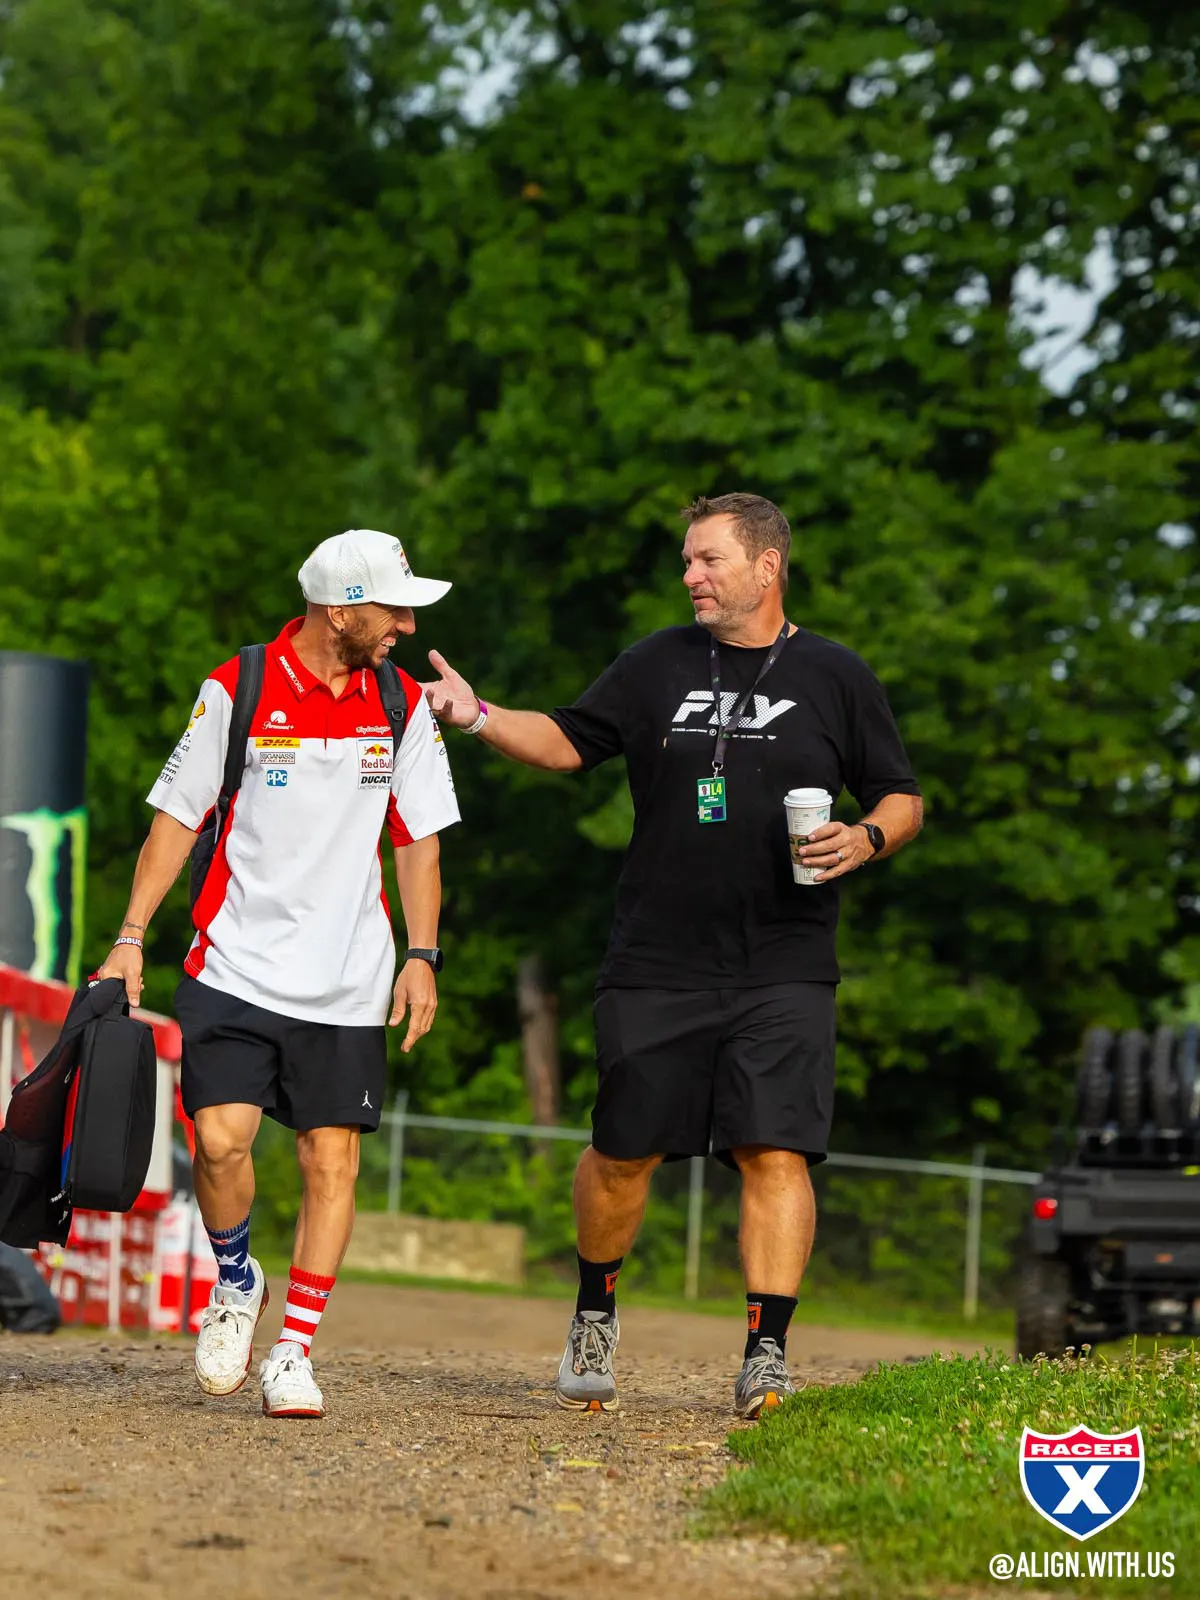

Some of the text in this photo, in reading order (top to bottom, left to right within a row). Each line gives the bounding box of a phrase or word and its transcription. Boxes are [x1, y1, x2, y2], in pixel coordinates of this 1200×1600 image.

[346, 587, 364, 599] PPG
[671, 690, 798, 729] FLY
[262, 739, 295, 748] DHL
[361, 759, 379, 769] Red
[267, 771, 288, 785] PPG
[361, 776, 392, 785] DUCAT
[711, 782, 723, 796] L4
